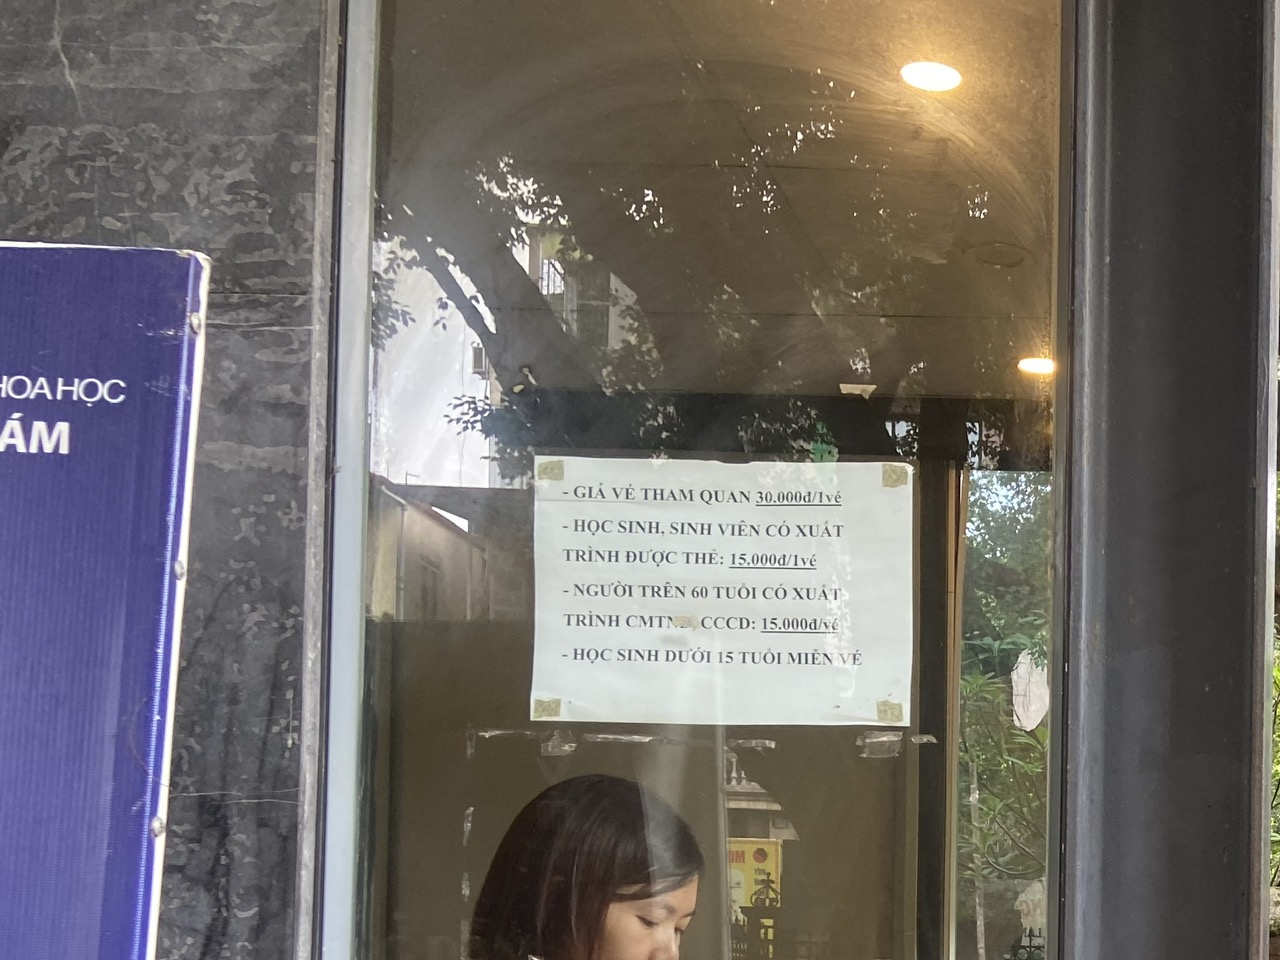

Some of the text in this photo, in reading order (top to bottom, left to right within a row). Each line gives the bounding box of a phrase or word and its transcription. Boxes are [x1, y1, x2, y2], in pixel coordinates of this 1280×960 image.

[56, 377, 127, 407] HỌC
[573, 483, 606, 499] GIÁ
[612, 484, 635, 500] VÉ
[641, 488, 694, 501] THAM
[700, 489, 751, 505] QUAN
[756, 490, 842, 506] 30.000đ/1vé
[573, 519, 613, 536] HỌC
[617, 520, 665, 536] SINH,
[669, 522, 712, 536] SINH
[718, 520, 760, 536] VIÊN
[765, 520, 790, 537] CÓ
[564, 546, 817, 569] TRÌNH ĐƯỢC THẺ: 15.000đ/1vé
[573, 581, 634, 597] NGƯỜI
[638, 582, 687, 599] TRÊN
[691, 586, 708, 599] 60
[713, 583, 757, 600] TUỔI
[762, 584, 787, 600] CÓ
[564, 611, 620, 627] TRÌNH
[700, 616, 756, 630] CCCD:
[573, 648, 612, 664] HỌC
[616, 649, 659, 662] SINH
[665, 647, 711, 664] DƯỚI
[717, 651, 734, 664] 15
[738, 648, 782, 665] TUỔI
[838, 650, 863, 666] VÉ
